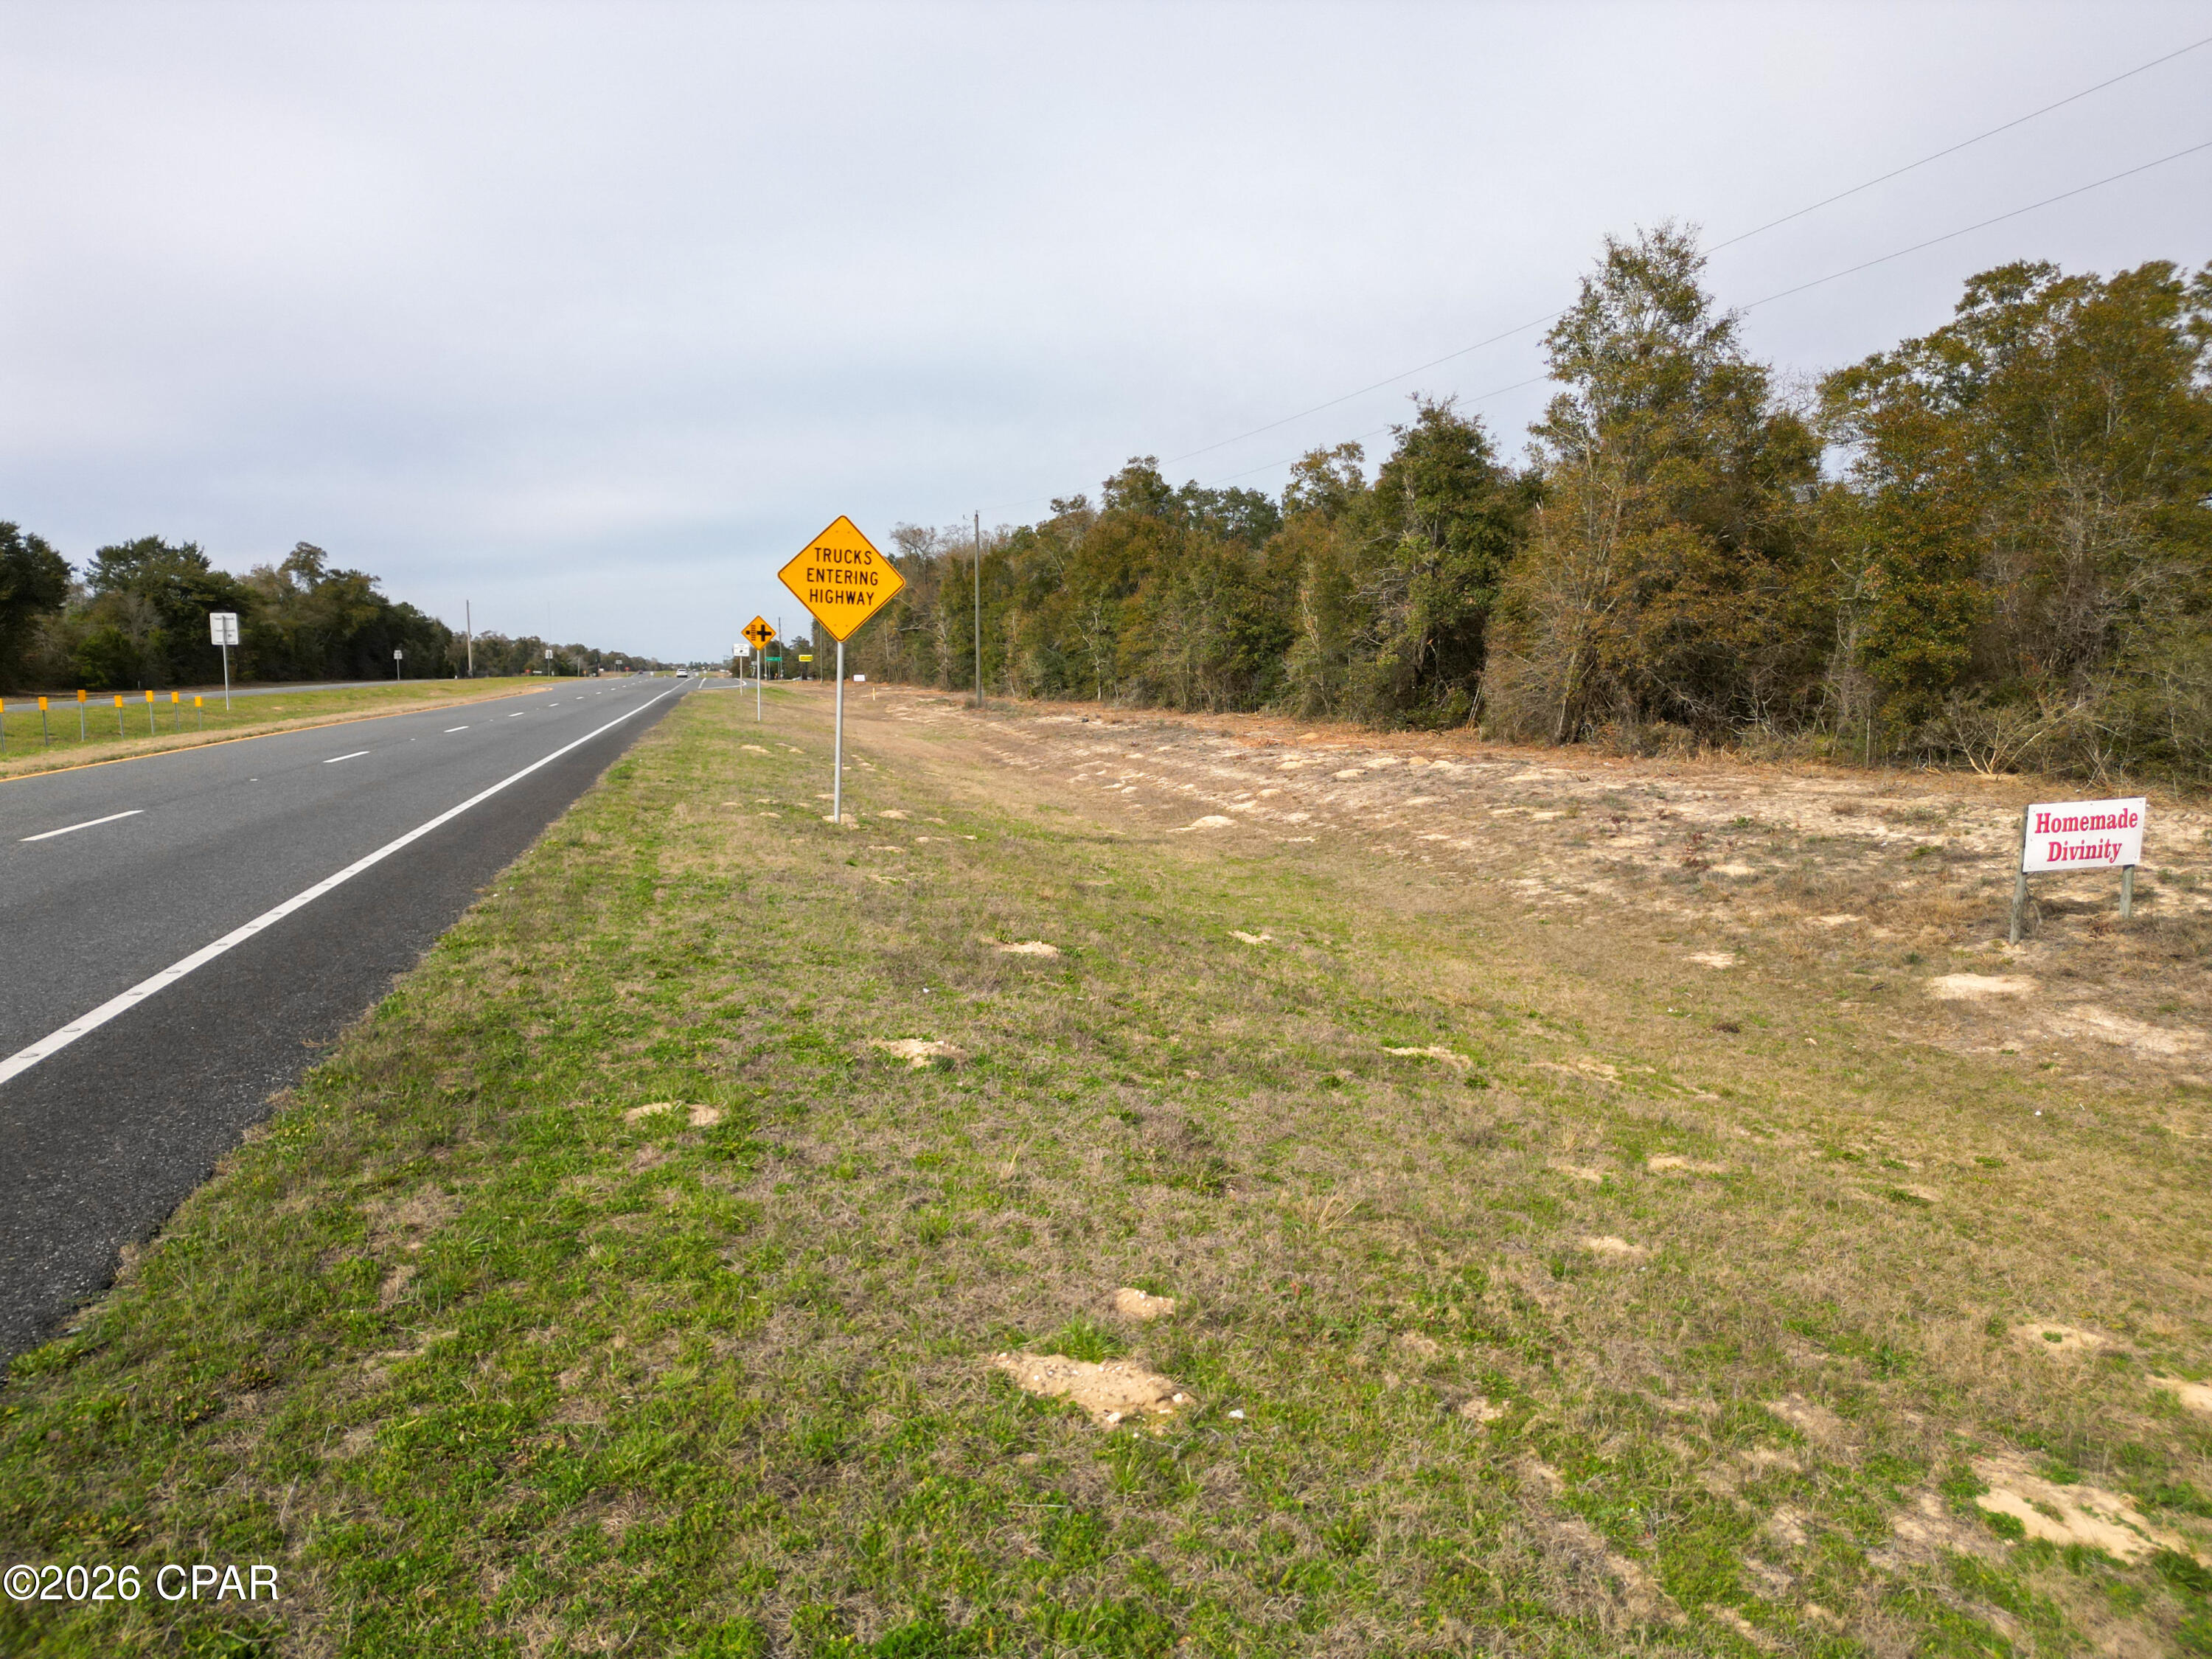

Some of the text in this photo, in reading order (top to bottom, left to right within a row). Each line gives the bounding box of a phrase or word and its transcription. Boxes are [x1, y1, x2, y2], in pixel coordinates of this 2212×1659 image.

[814, 547, 872, 566] TRUCKS
[807, 568, 879, 586] ENTERING
[810, 588, 874, 606] HIGHWAY
[2034, 808, 2138, 834] Homemade
[2047, 838, 2123, 864] Divinity
